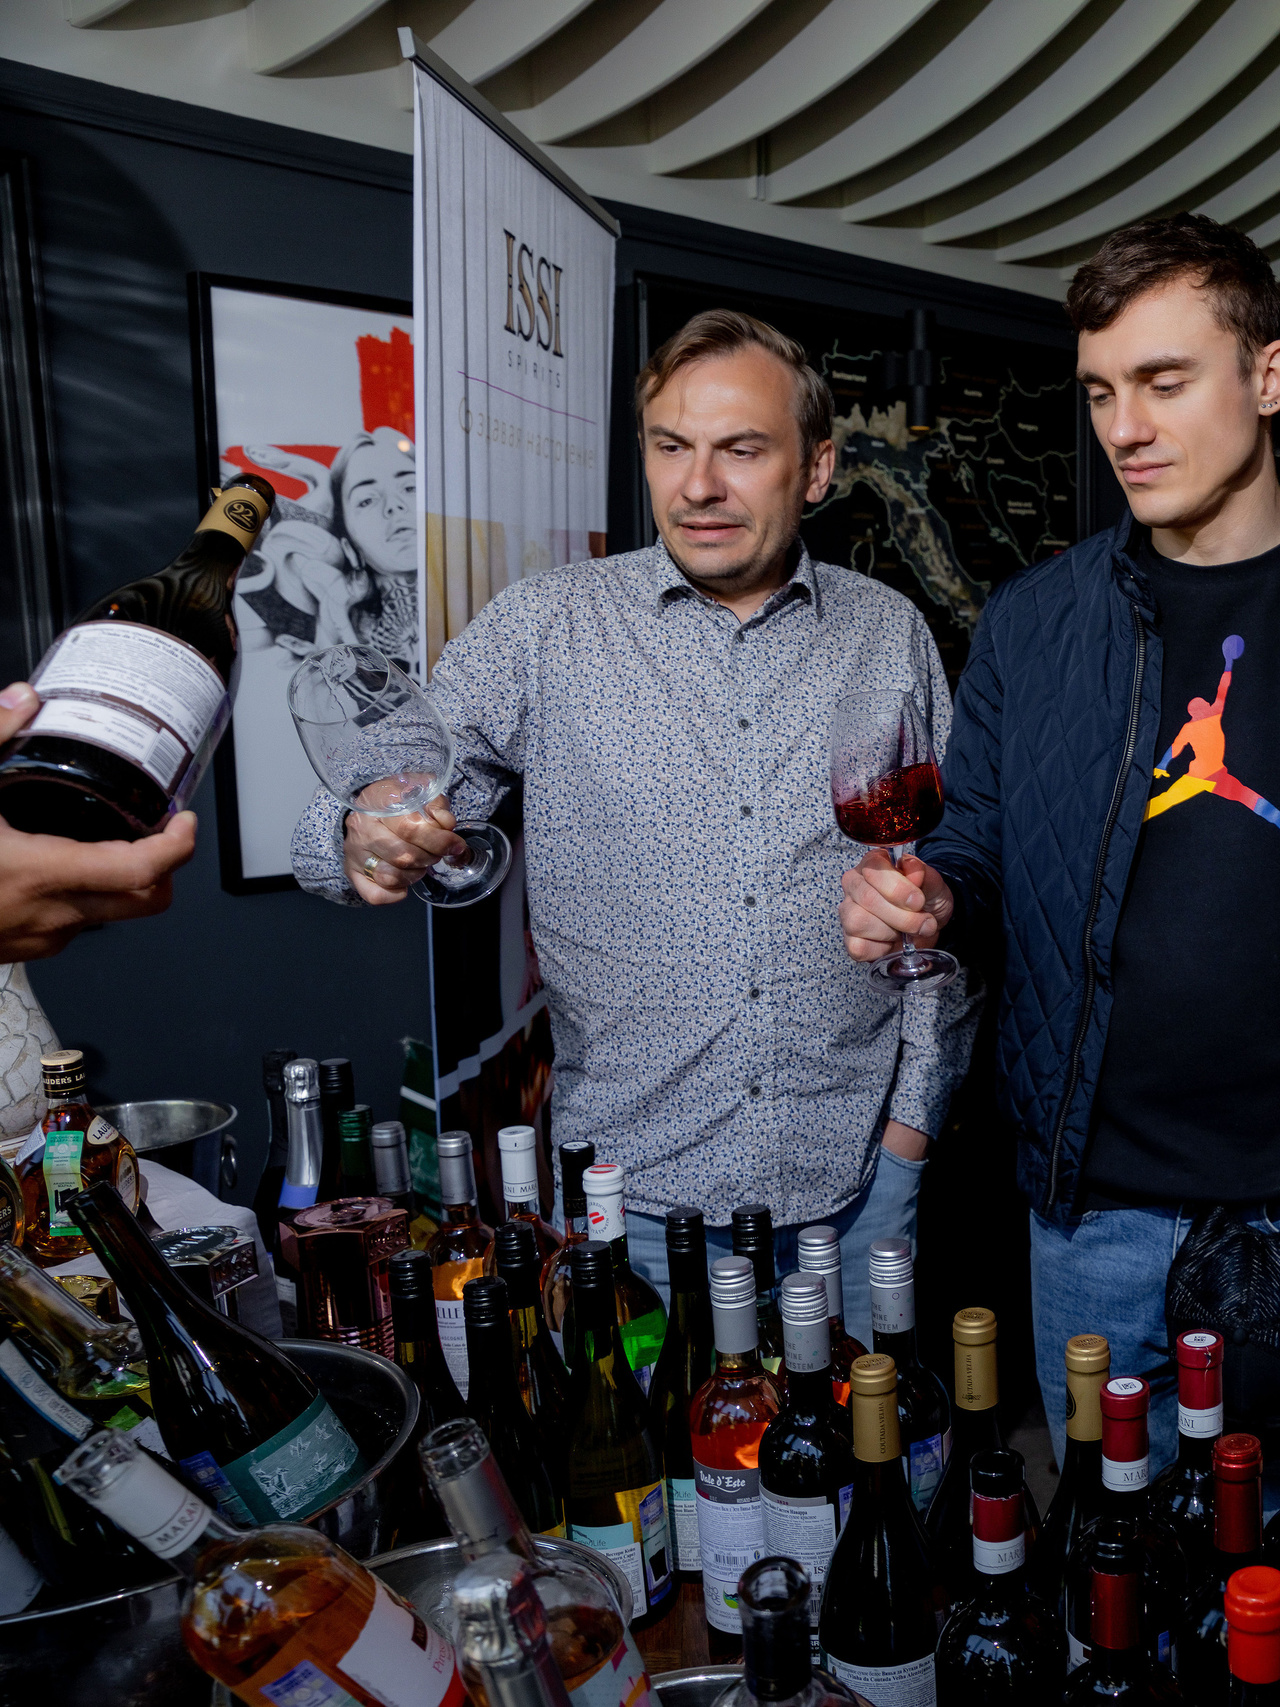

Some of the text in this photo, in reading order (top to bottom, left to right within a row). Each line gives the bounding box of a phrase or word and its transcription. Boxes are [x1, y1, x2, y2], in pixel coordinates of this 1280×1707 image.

[503, 228, 563, 359] ISSI
[508, 350, 561, 389] SPIRITS
[231, 503, 254, 521] 92
[42, 1074, 72, 1086] AUDER'S
[93, 1122, 112, 1140] LAUD
[0, 1205, 12, 1219] ER'S
[785, 1353, 803, 1361] WINE
[700, 1470, 746, 1488] Vale d'Este
[813, 1566, 827, 1575] ISS
